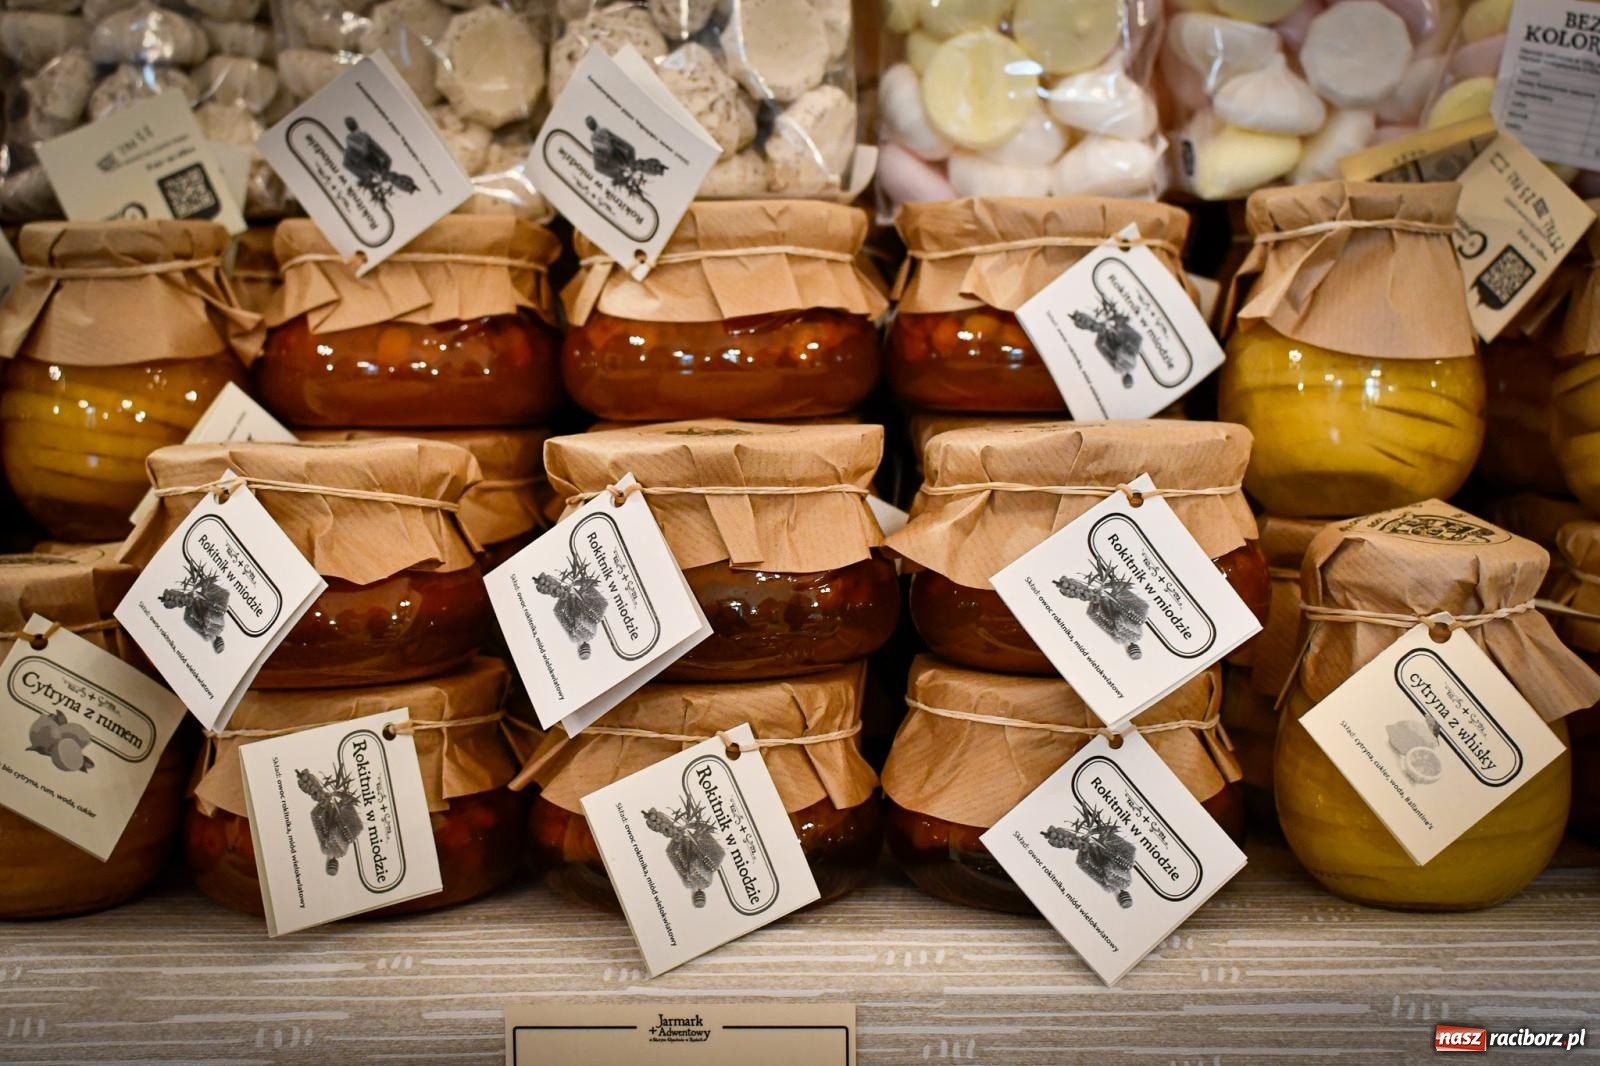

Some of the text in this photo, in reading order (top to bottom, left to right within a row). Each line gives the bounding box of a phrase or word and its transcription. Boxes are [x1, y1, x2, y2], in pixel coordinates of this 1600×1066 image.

[197, 533, 265, 618] Rokitnik w miodzie
[586, 531, 640, 641] Rokitnik w miodzie
[1106, 532, 1193, 641] Rokitnik w miodzie
[1037, 595, 1053, 613] owoc
[1050, 612, 1075, 641] rokitnika,
[1073, 640, 1089, 656] miód
[1086, 655, 1124, 699] wielokwiatowy
[20, 670, 144, 750] Cytryna z rumem
[1408, 671, 1498, 772] cytryna z whisky
[277, 779, 285, 799] owoc
[280, 800, 291, 834] rokitnika,
[351, 738, 389, 883] Rokitnik w miodzie
[695, 764, 762, 905] Rokitnik w miodzie
[1090, 776, 1180, 882] Rokitnik w miodzie
[287, 835, 296, 854] miód
[291, 854, 305, 908] wielokwiatowy
[624, 824, 635, 843] owoc
[632, 843, 649, 877] rokitnika,
[646, 876, 658, 895] miód
[653, 894, 678, 946] wielokwiatowy
[1027, 848, 1043, 867] owoc
[1041, 865, 1066, 894] rokitnika,
[1065, 892, 1081, 909] miód
[1078, 907, 1119, 953] wielokwiatowy
[656, 1014, 704, 1028] Jarmark
[658, 1027, 711, 1041] Adwentowy
